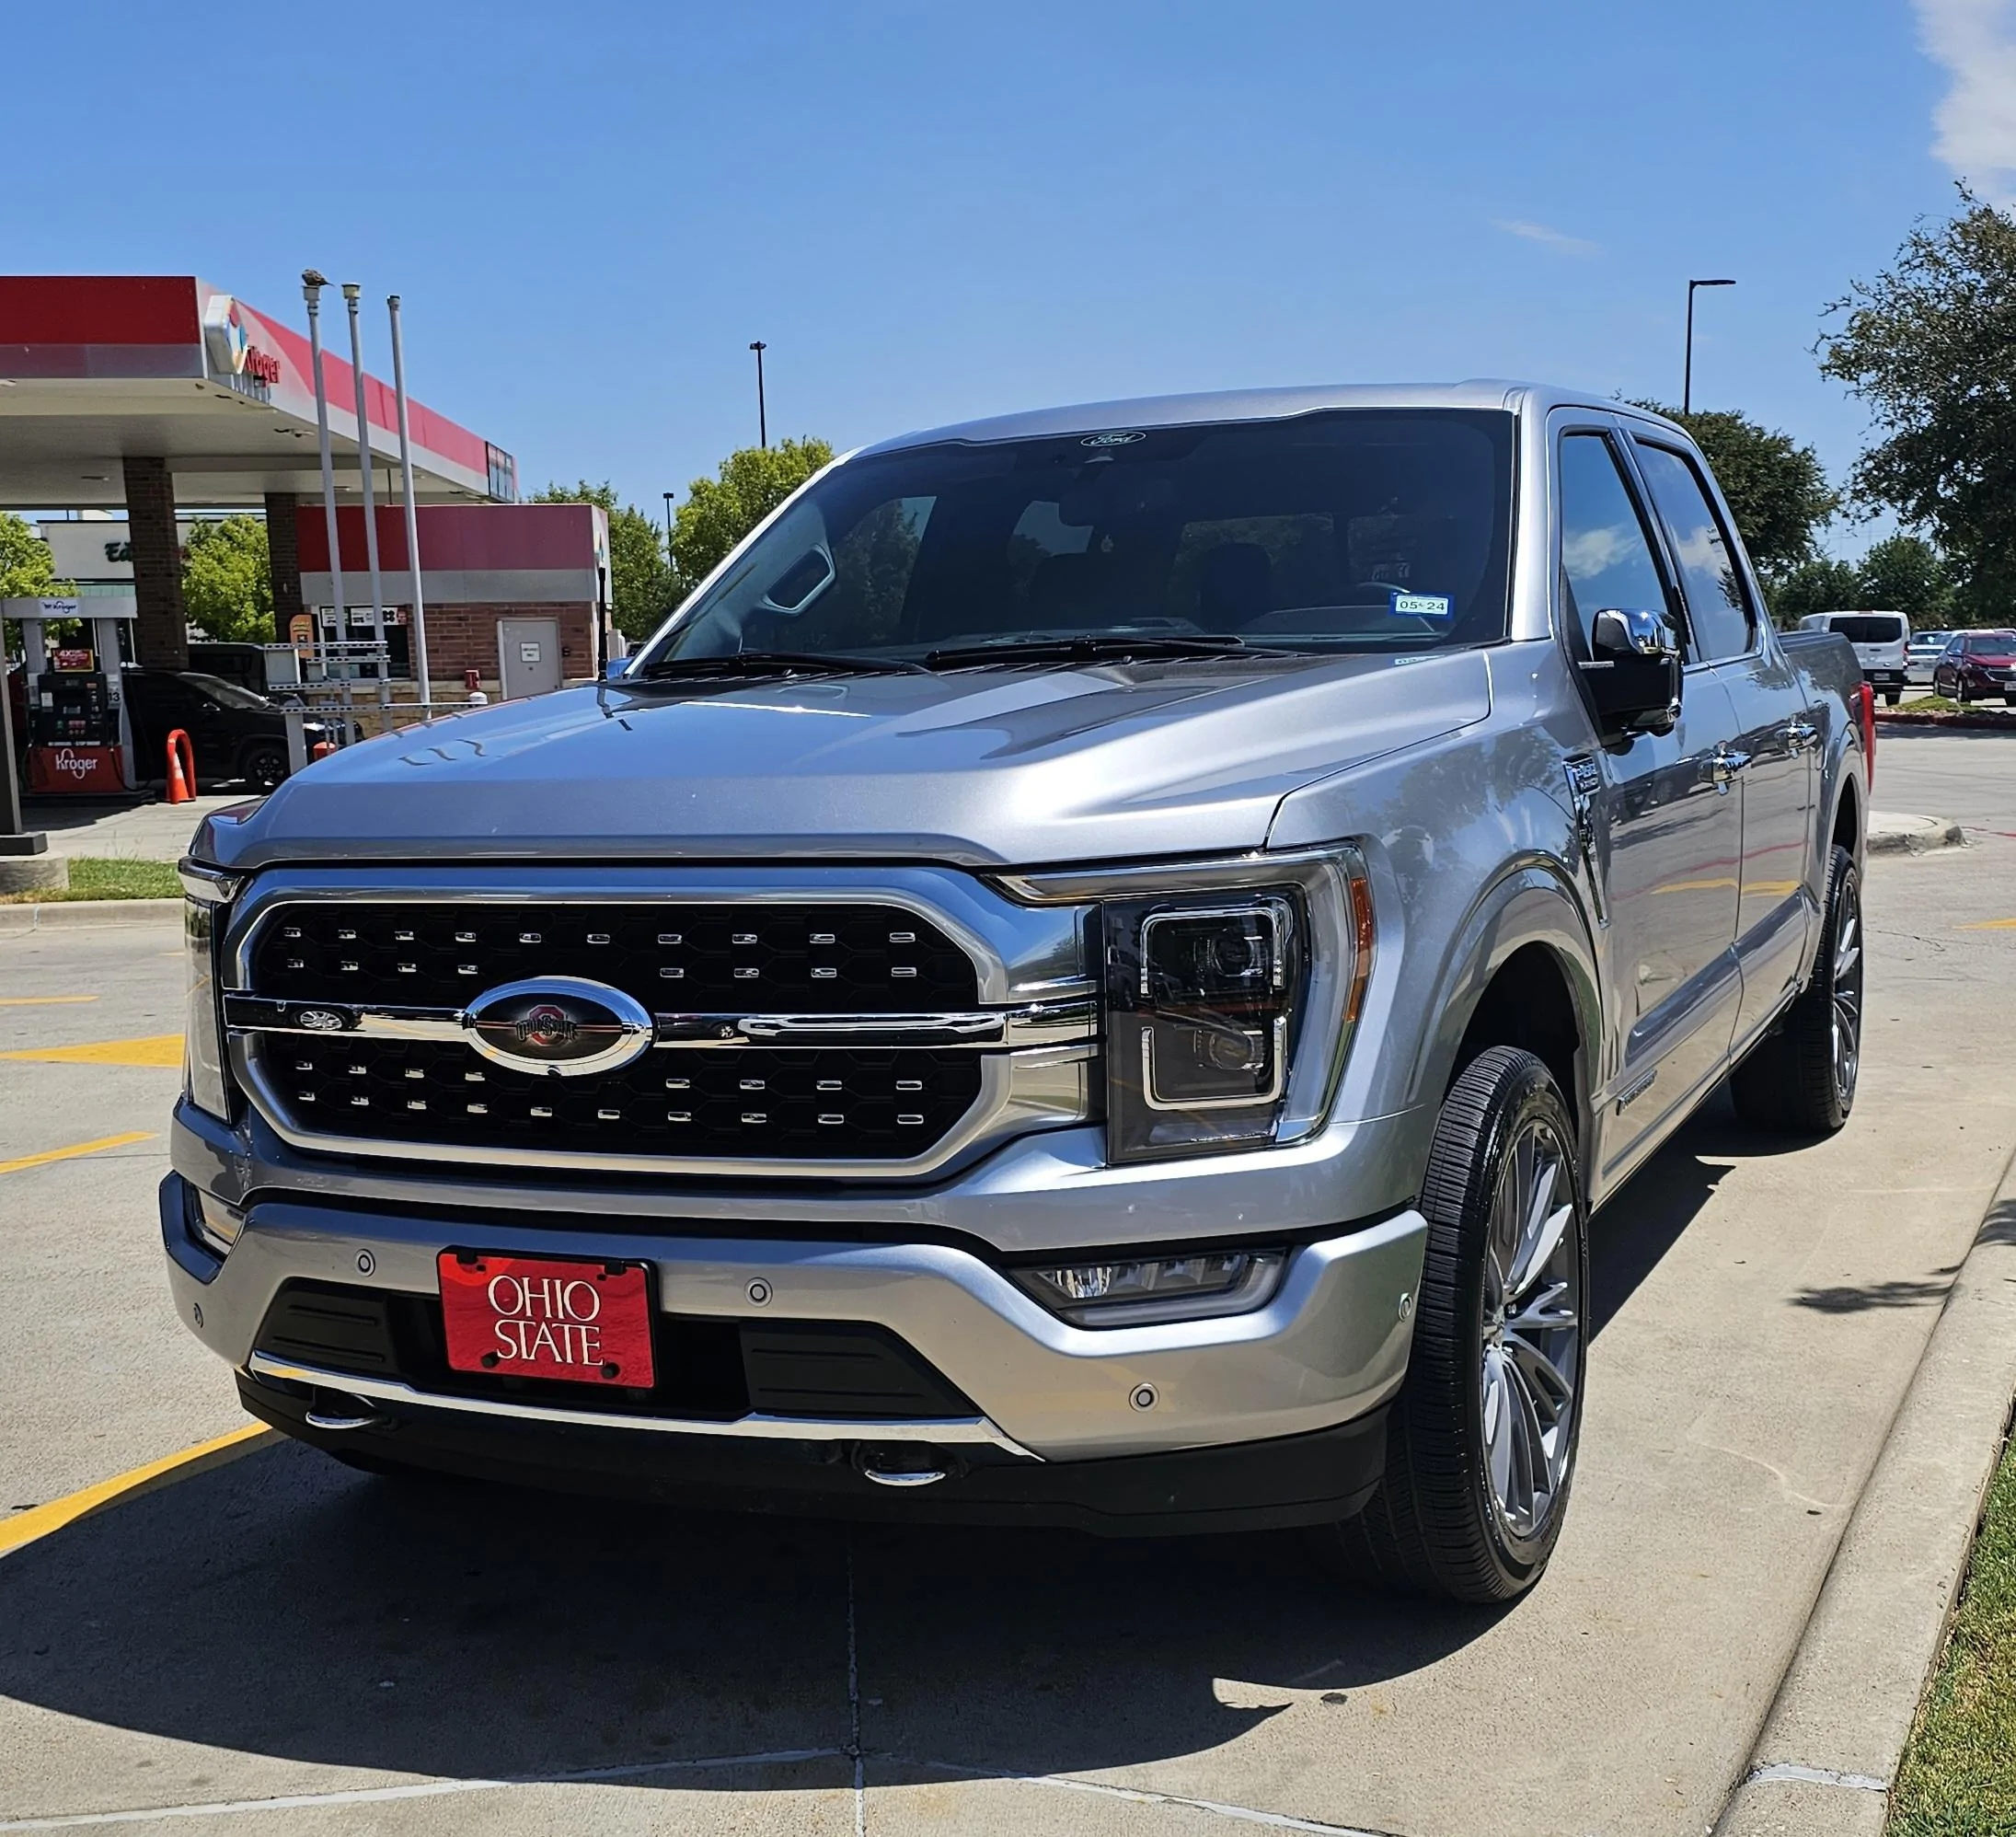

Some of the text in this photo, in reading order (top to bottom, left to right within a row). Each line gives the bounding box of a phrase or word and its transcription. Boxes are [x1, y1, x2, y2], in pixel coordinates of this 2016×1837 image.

[1090, 433, 1135, 445] Ford
[1400, 600, 1445, 611] 05 24
[109, 692, 121, 701] 13
[55, 748, 98, 780] Kroger
[488, 1275, 600, 1322] OHIO
[495, 1319, 604, 1366] STATE
